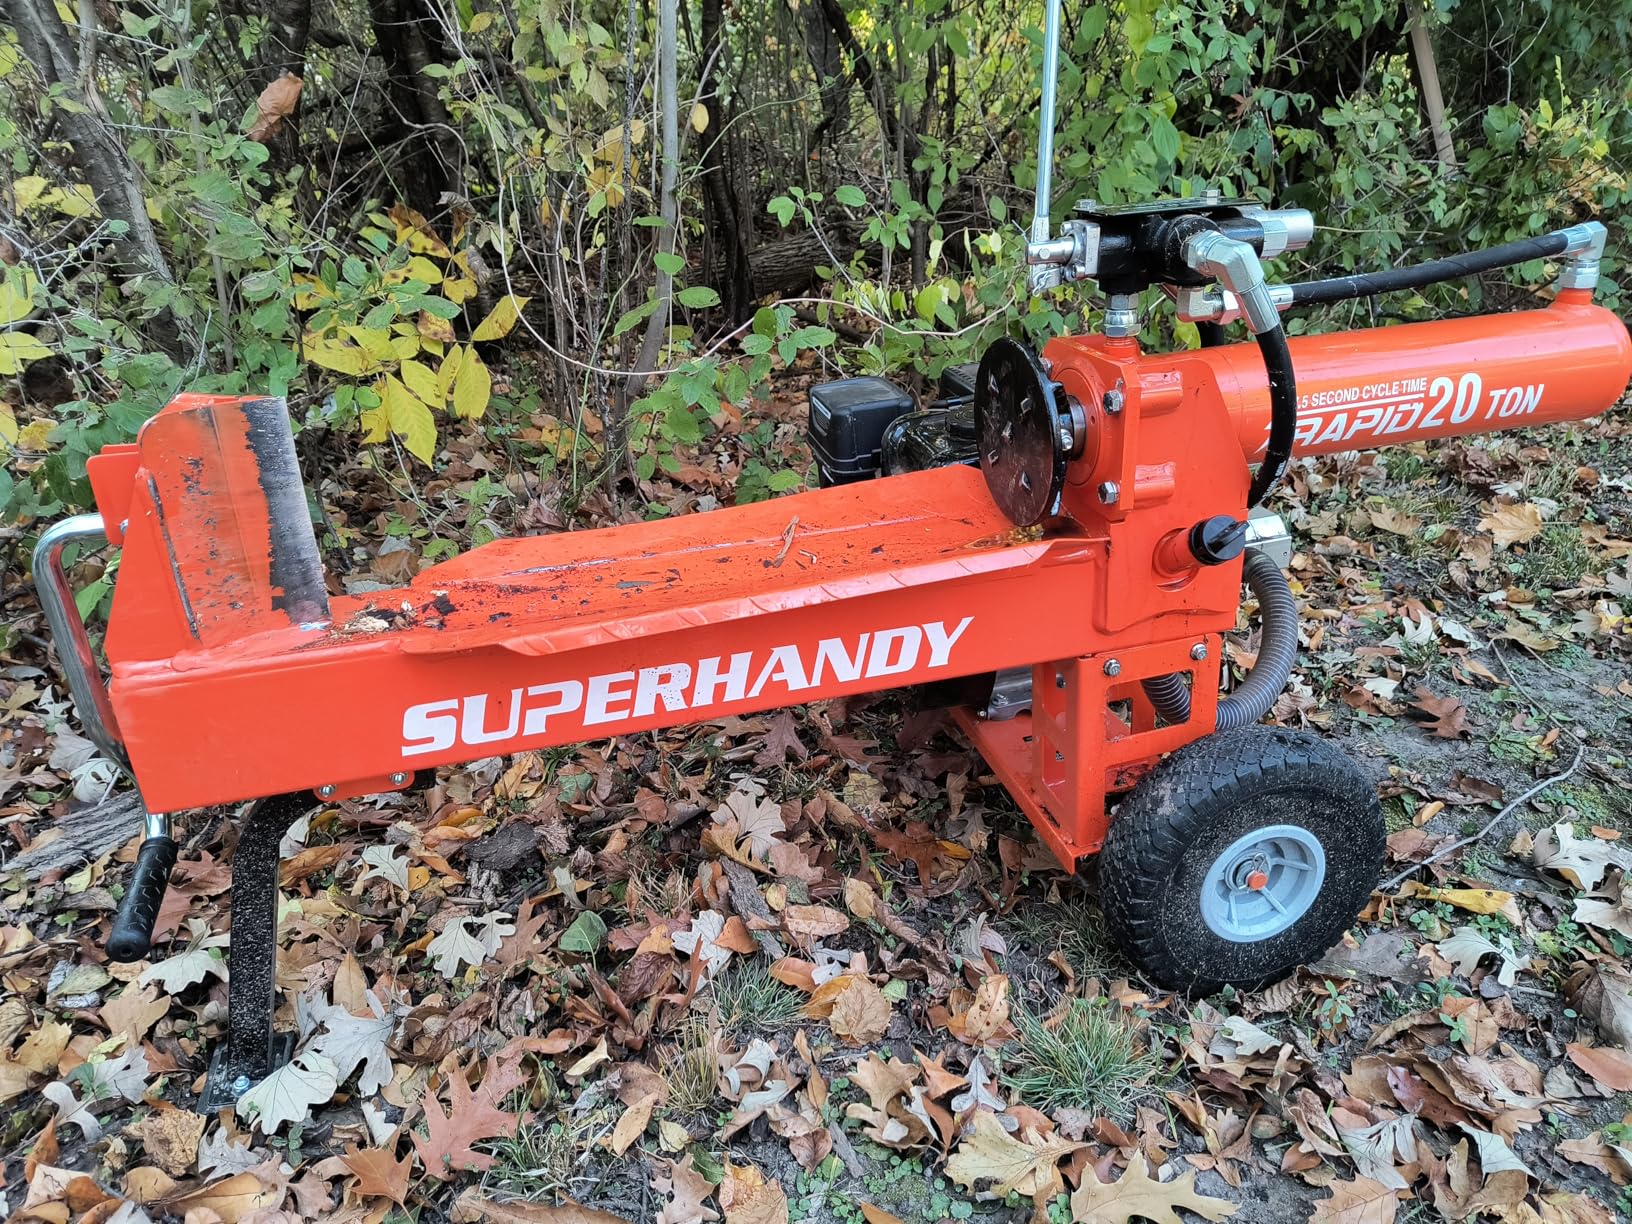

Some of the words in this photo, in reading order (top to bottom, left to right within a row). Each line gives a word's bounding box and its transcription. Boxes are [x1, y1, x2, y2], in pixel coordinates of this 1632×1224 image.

[1311, 387, 1360, 407] SECOND
[1362, 381, 1400, 400] CYCLE
[1401, 377, 1428, 393] TIME
[1417, 372, 1483, 429] 20
[1484, 384, 1545, 420] TON
[401, 616, 975, 757] SUPERHANDY
